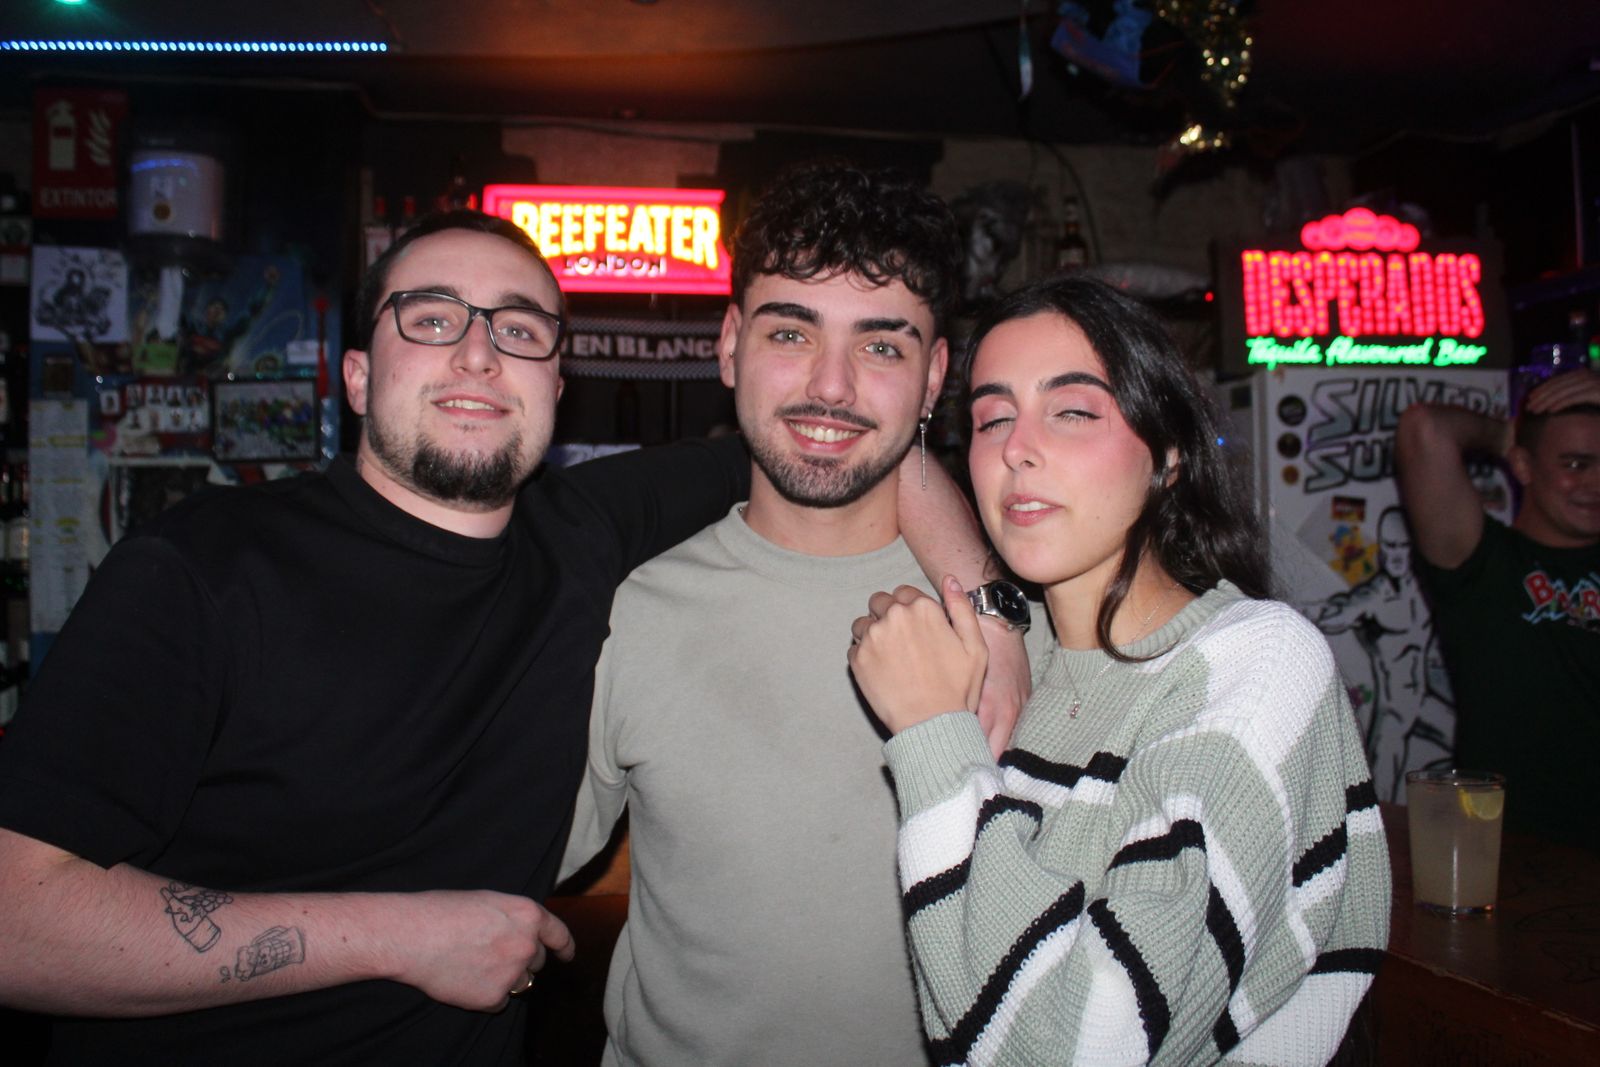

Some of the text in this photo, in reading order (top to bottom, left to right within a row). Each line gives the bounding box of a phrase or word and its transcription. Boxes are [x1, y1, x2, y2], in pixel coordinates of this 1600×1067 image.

[39, 187, 119, 208] EXTINTOR
[512, 202, 720, 269] BEEFEATER
[562, 254, 667, 277] LONDON
[1242, 250, 1485, 338] DESPERADOS
[572, 333, 612, 357] EN
[1246, 336, 1323, 371] Tequila
[1433, 338, 1487, 366] Beer
